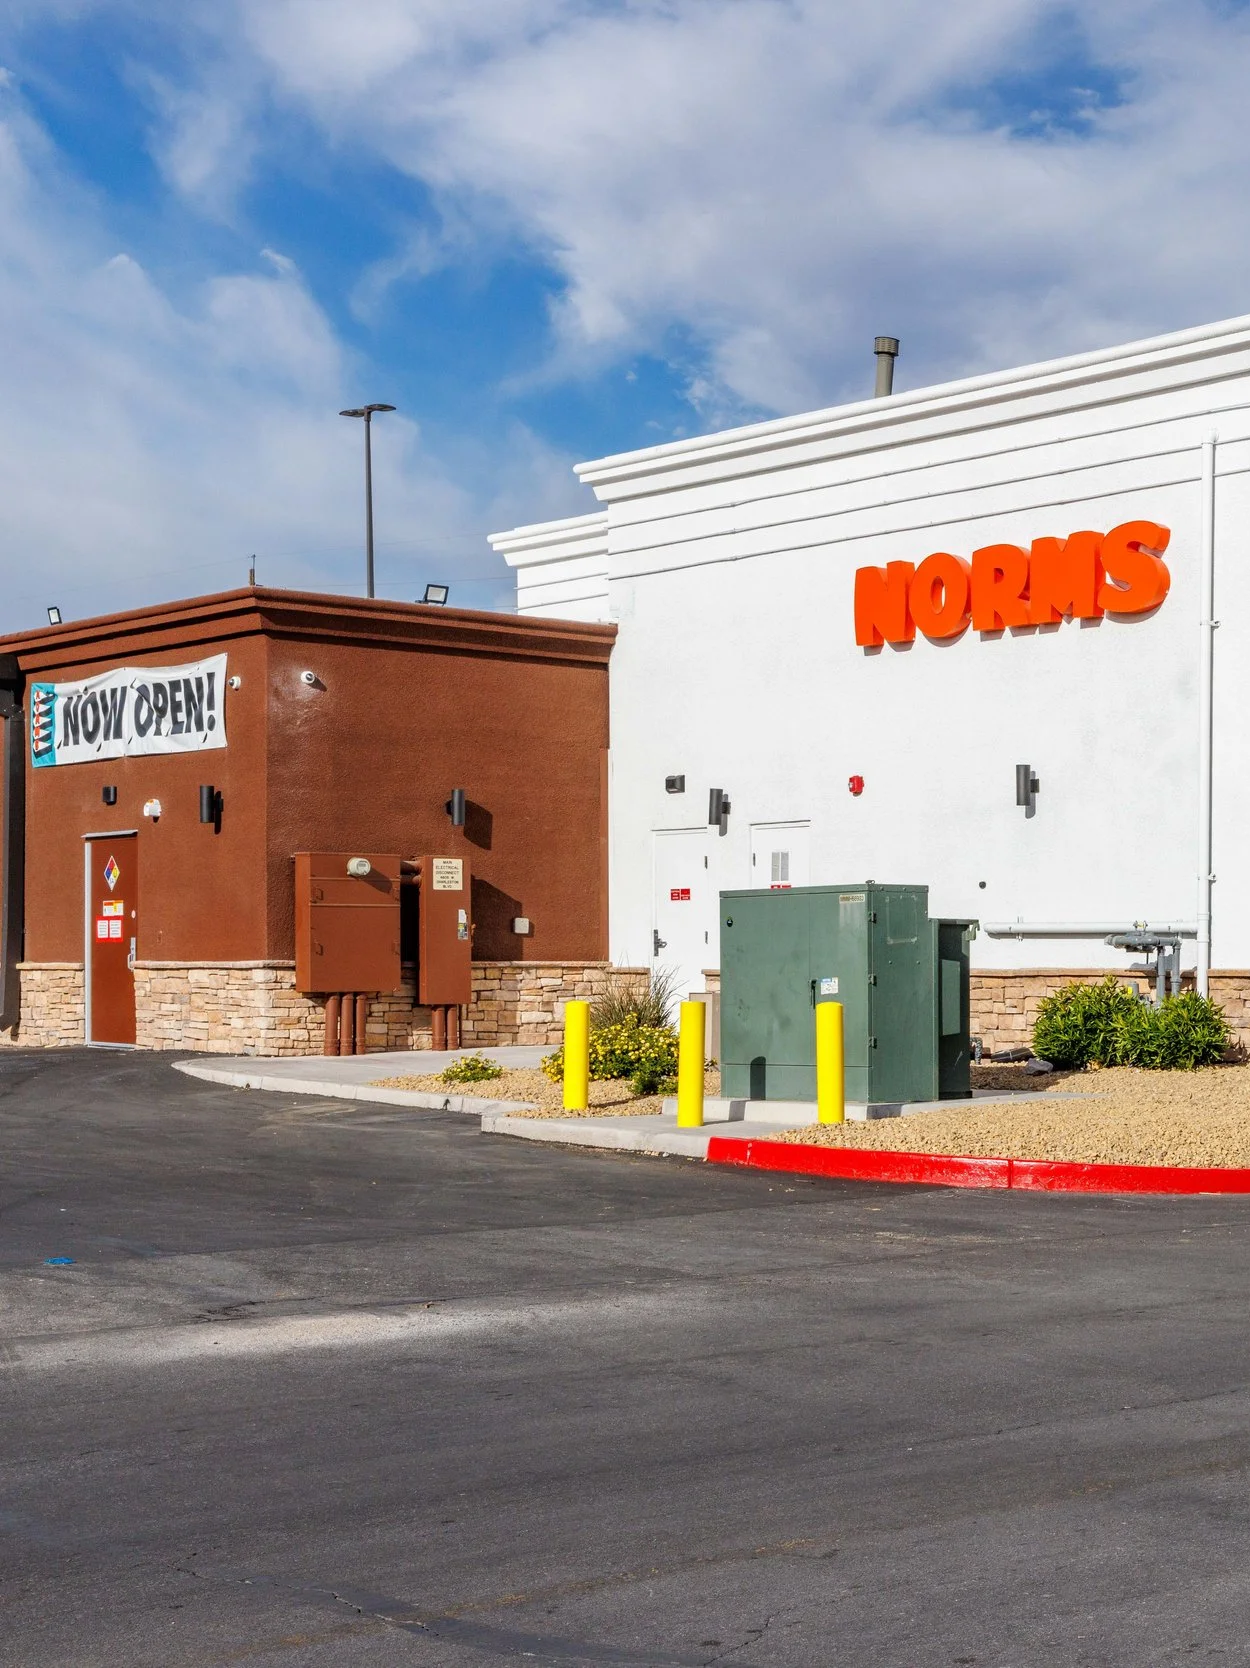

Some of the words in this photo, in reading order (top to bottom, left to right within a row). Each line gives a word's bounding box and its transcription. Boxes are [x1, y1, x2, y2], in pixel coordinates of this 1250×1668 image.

[854, 520, 1171, 646] NORMS
[62, 685, 128, 747] NOW
[134, 671, 216, 738] OPEN!
